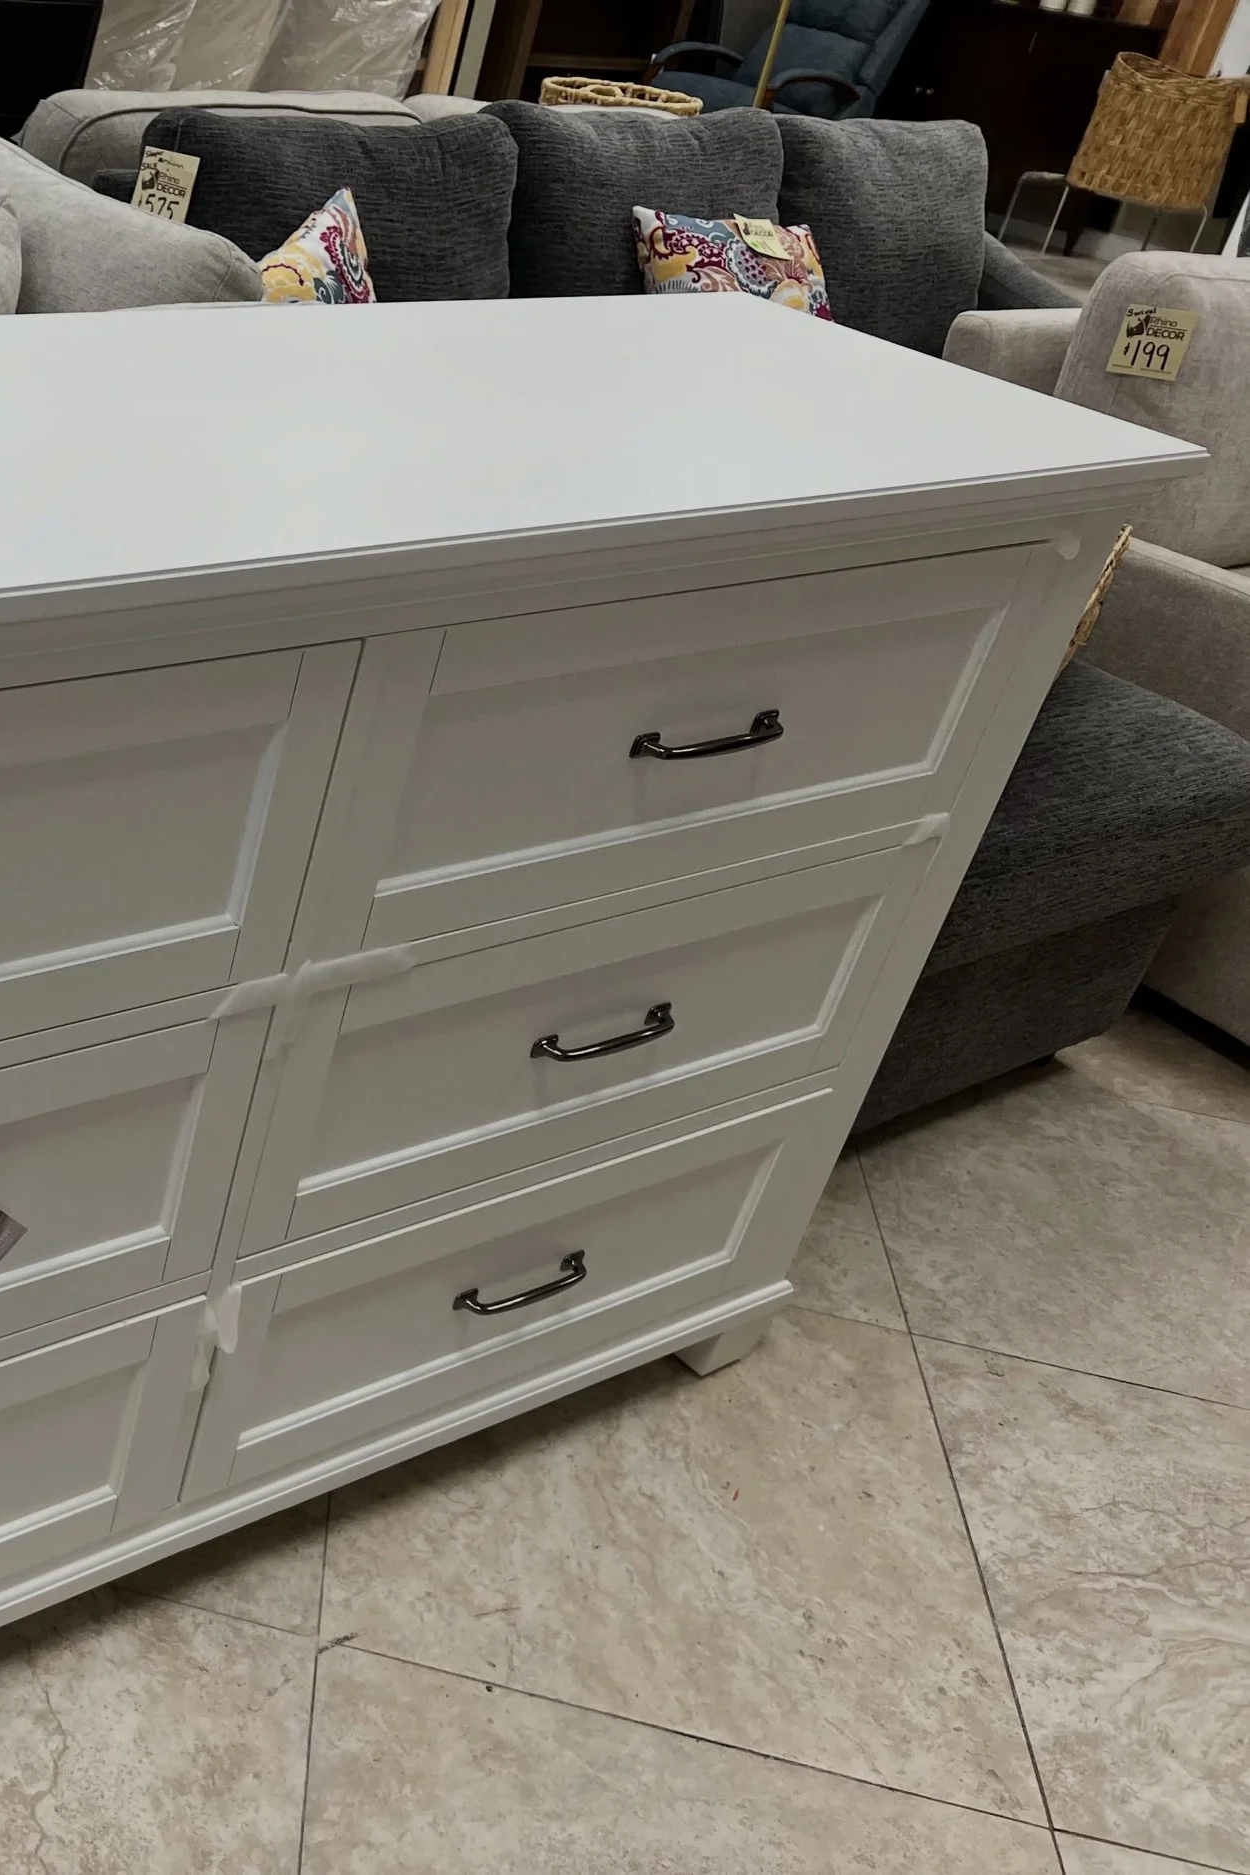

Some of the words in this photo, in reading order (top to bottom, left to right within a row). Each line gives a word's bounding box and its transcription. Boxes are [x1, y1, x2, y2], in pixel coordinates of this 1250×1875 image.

[157, 183, 186, 198] DECOR
[1150, 316, 1177, 327] Rhino
[1146, 327, 1185, 341] DECOR
[1123, 339, 1170, 371] $199
